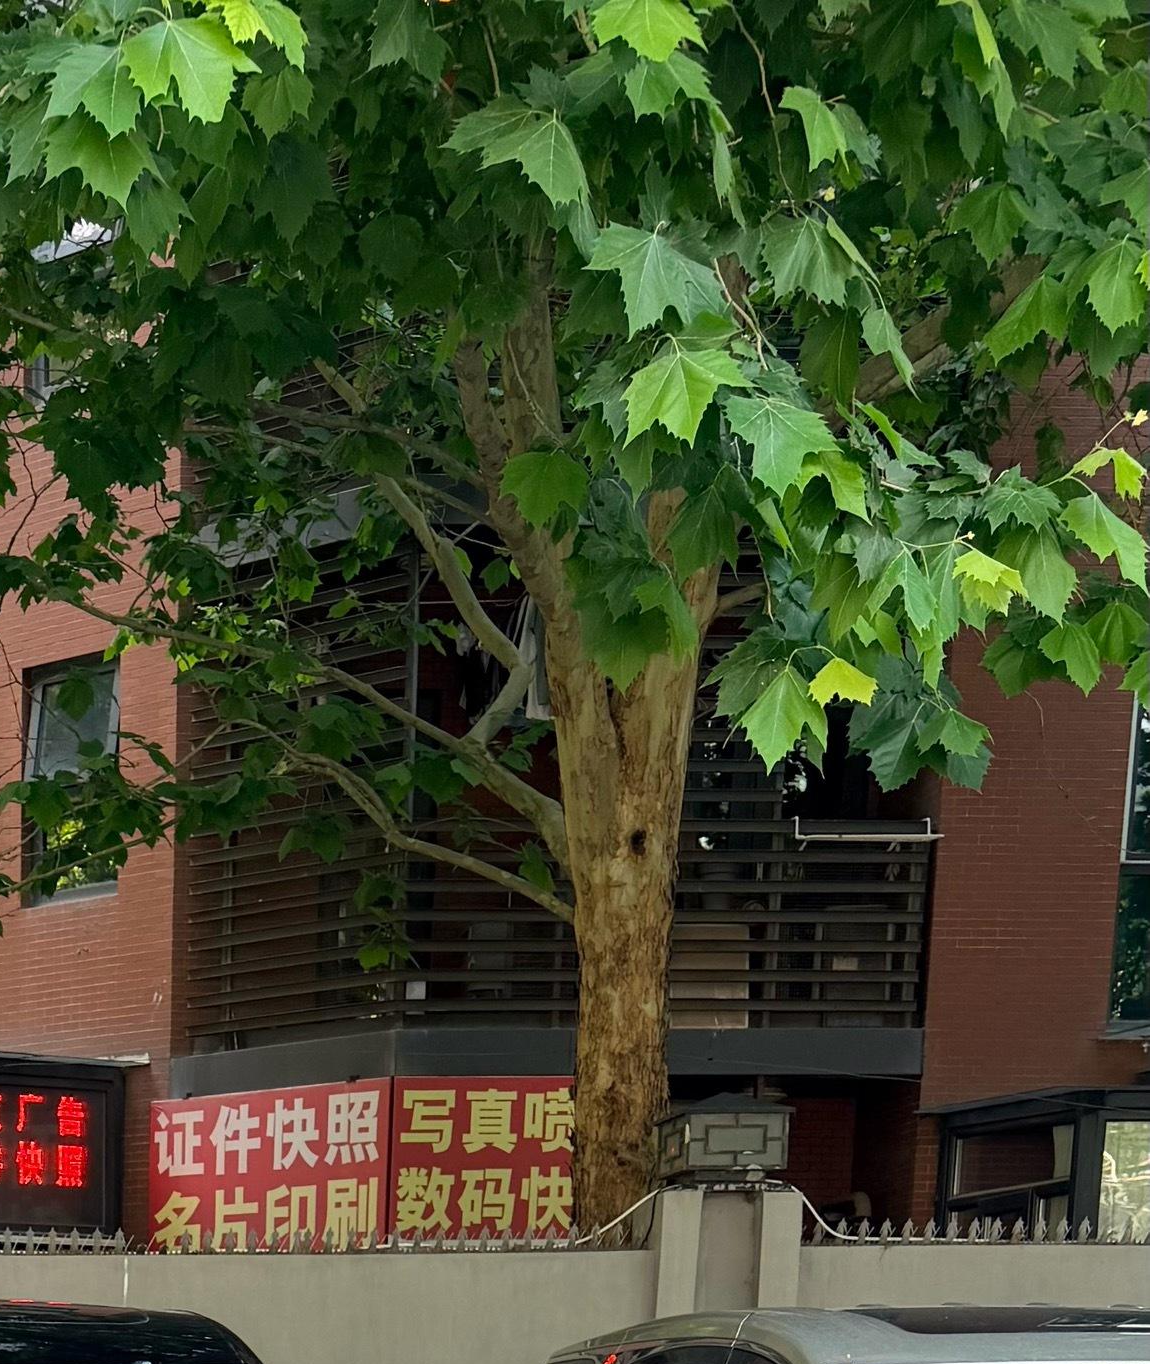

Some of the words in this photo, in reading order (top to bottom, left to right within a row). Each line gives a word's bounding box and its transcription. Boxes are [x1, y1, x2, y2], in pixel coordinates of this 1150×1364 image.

[154, 1090, 380, 1177] 证件快照
[154, 1177, 379, 1254] 名片印刷
